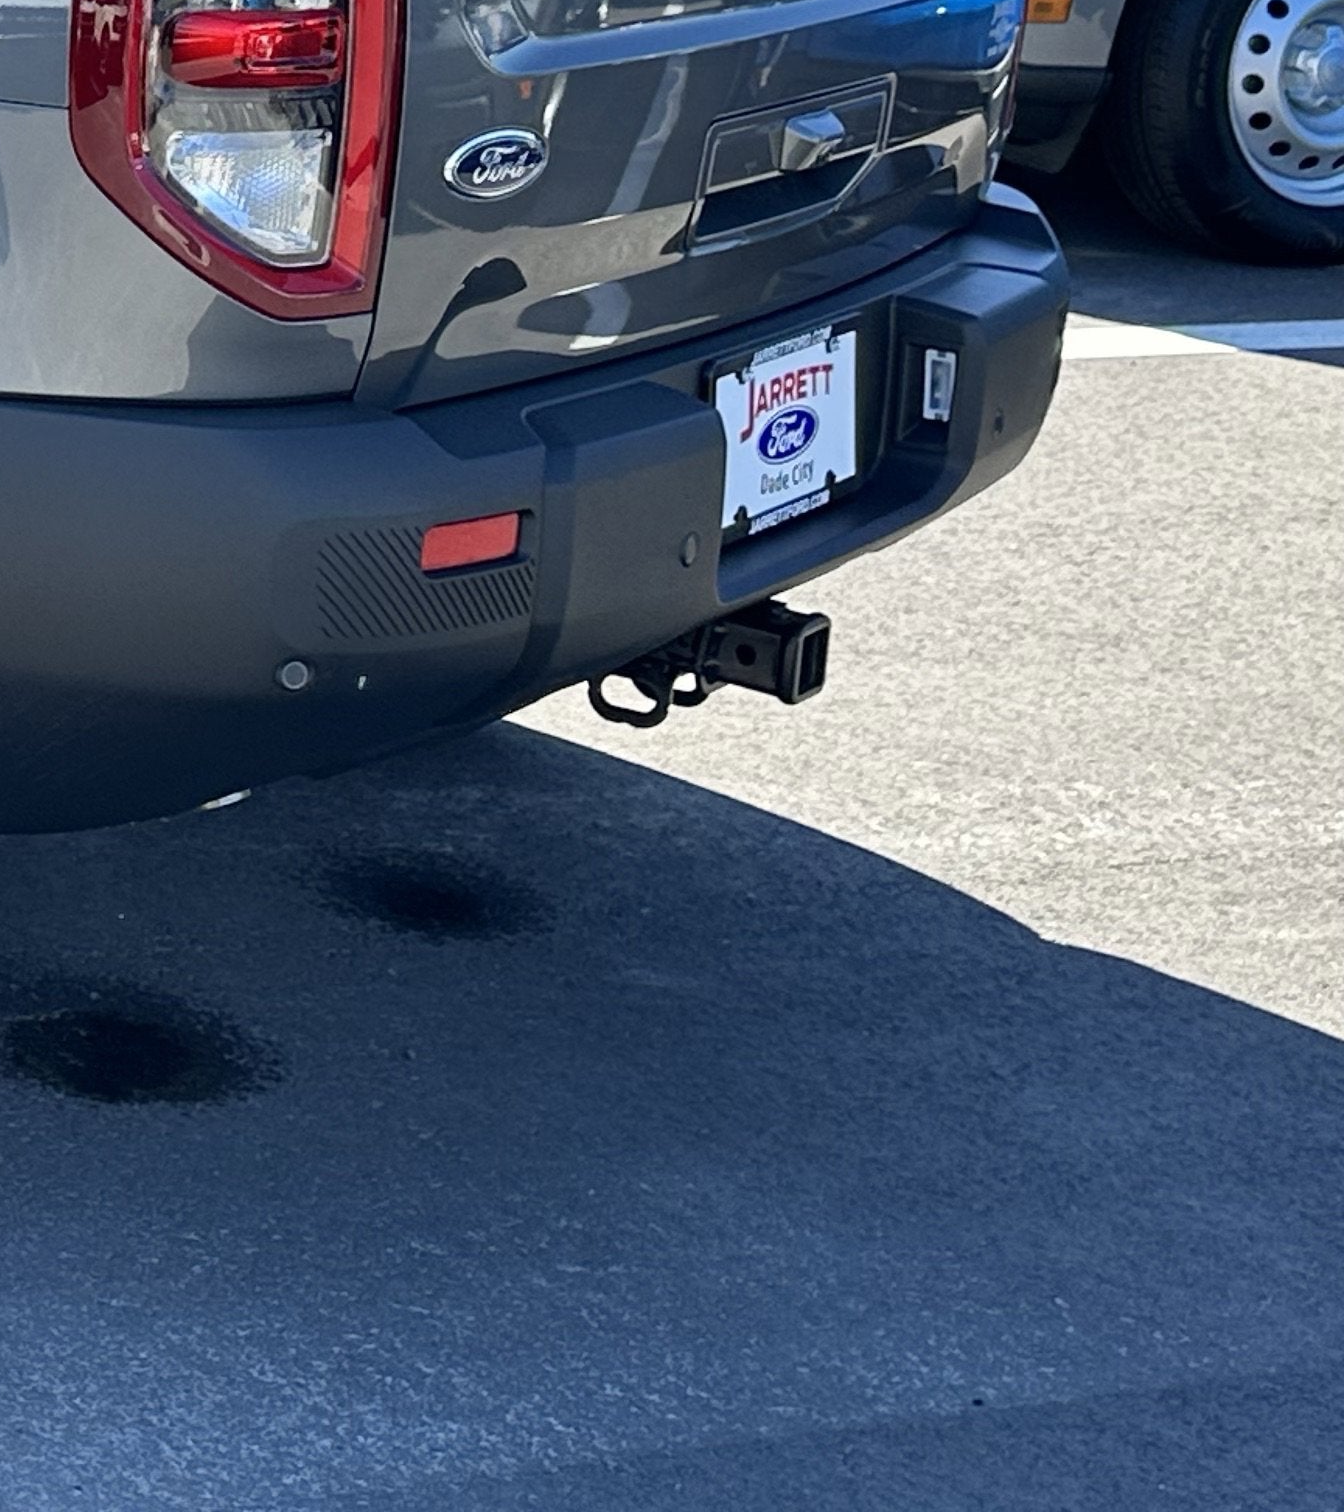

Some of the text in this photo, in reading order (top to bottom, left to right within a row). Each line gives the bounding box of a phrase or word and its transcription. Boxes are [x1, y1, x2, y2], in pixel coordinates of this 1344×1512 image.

[472, 145, 535, 185] Ford
[740, 363, 834, 444] JARRETT
[766, 413, 809, 458] Ford
[760, 469, 790, 495] Dade
